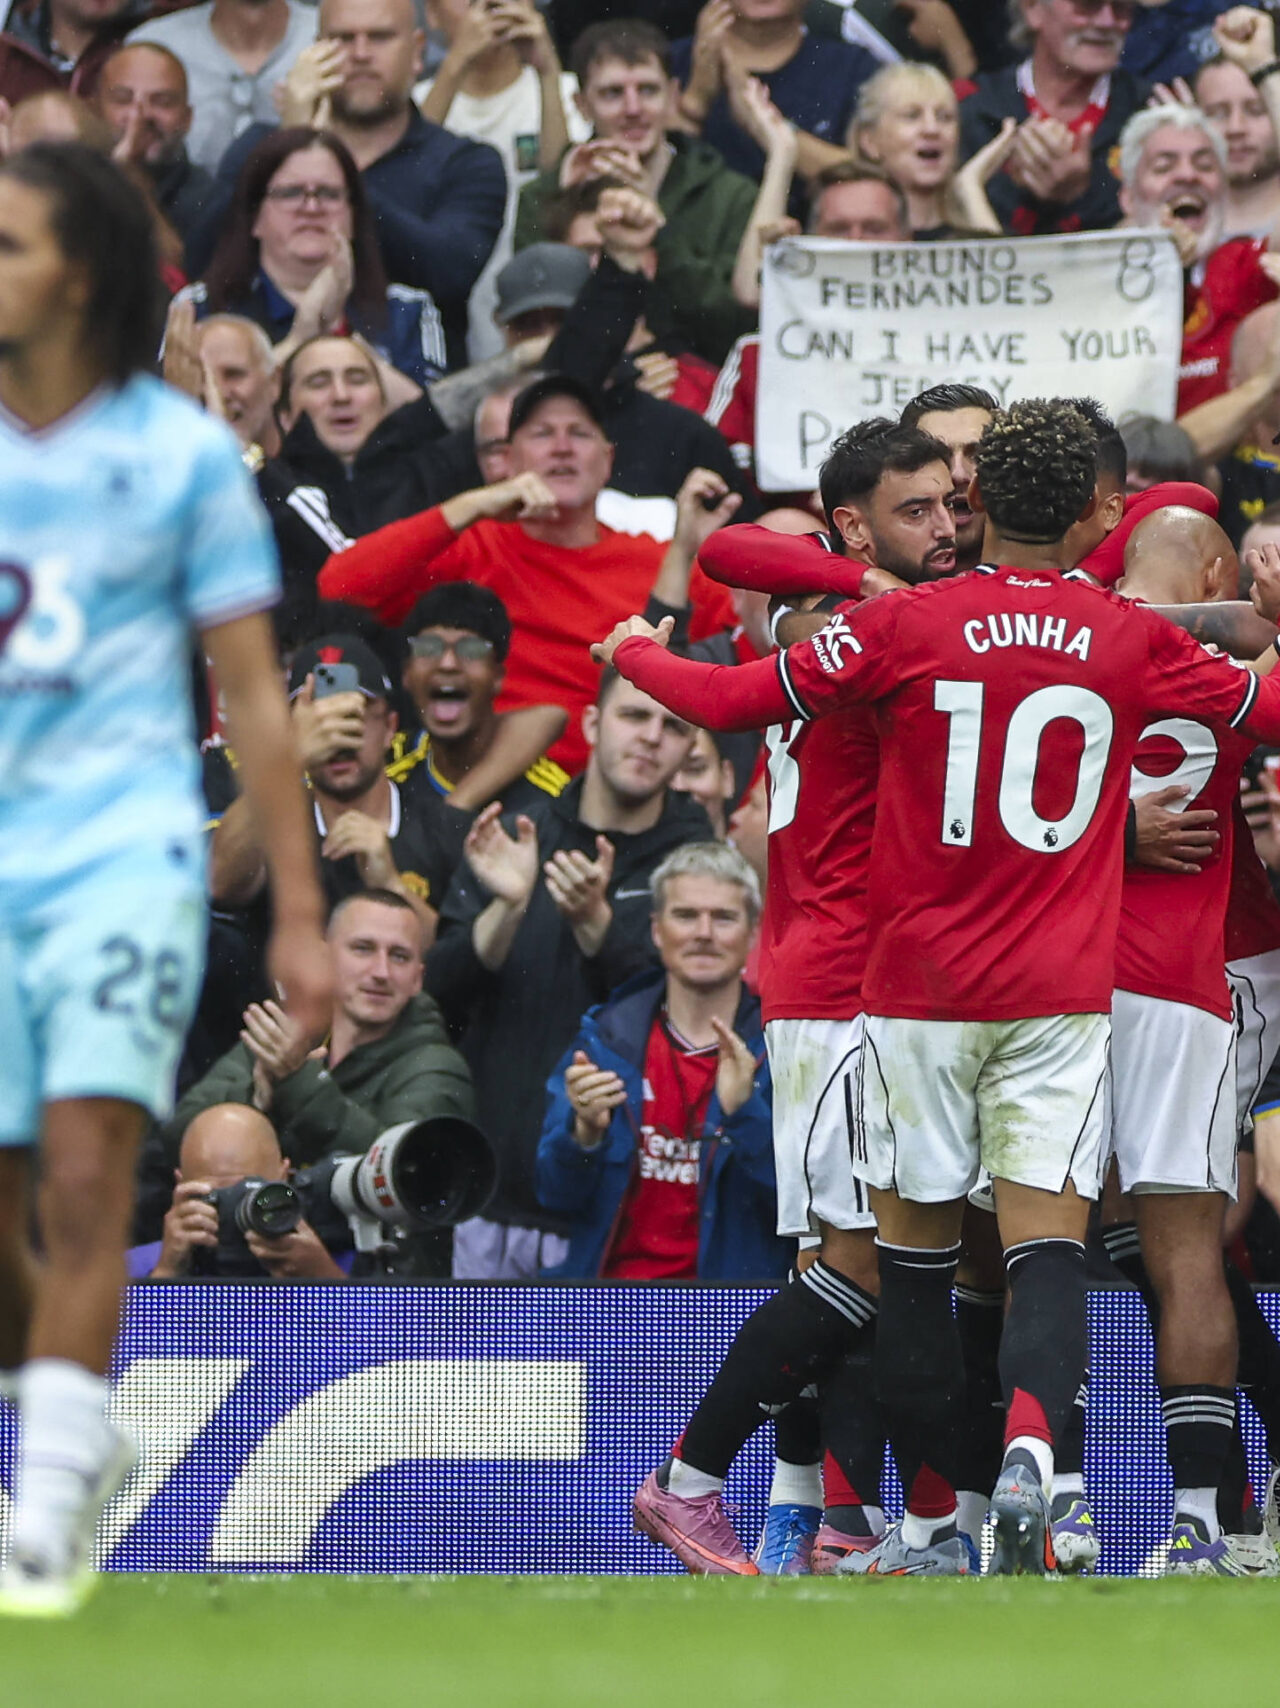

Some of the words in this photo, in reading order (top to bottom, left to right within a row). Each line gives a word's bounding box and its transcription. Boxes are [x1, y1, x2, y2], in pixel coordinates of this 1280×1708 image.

[872, 245, 1017, 279] BRUNO
[1115, 236, 1158, 302] 8
[820, 273, 1055, 309] FERNANDES
[776, 319, 855, 362] CAN
[880, 332, 898, 362] I
[926, 333, 1027, 365] HAVE
[1059, 326, 1158, 362] YOUR
[861, 372, 1014, 406] JEY
[963, 612, 1093, 662] CUNHA
[934, 680, 1114, 853] 10
